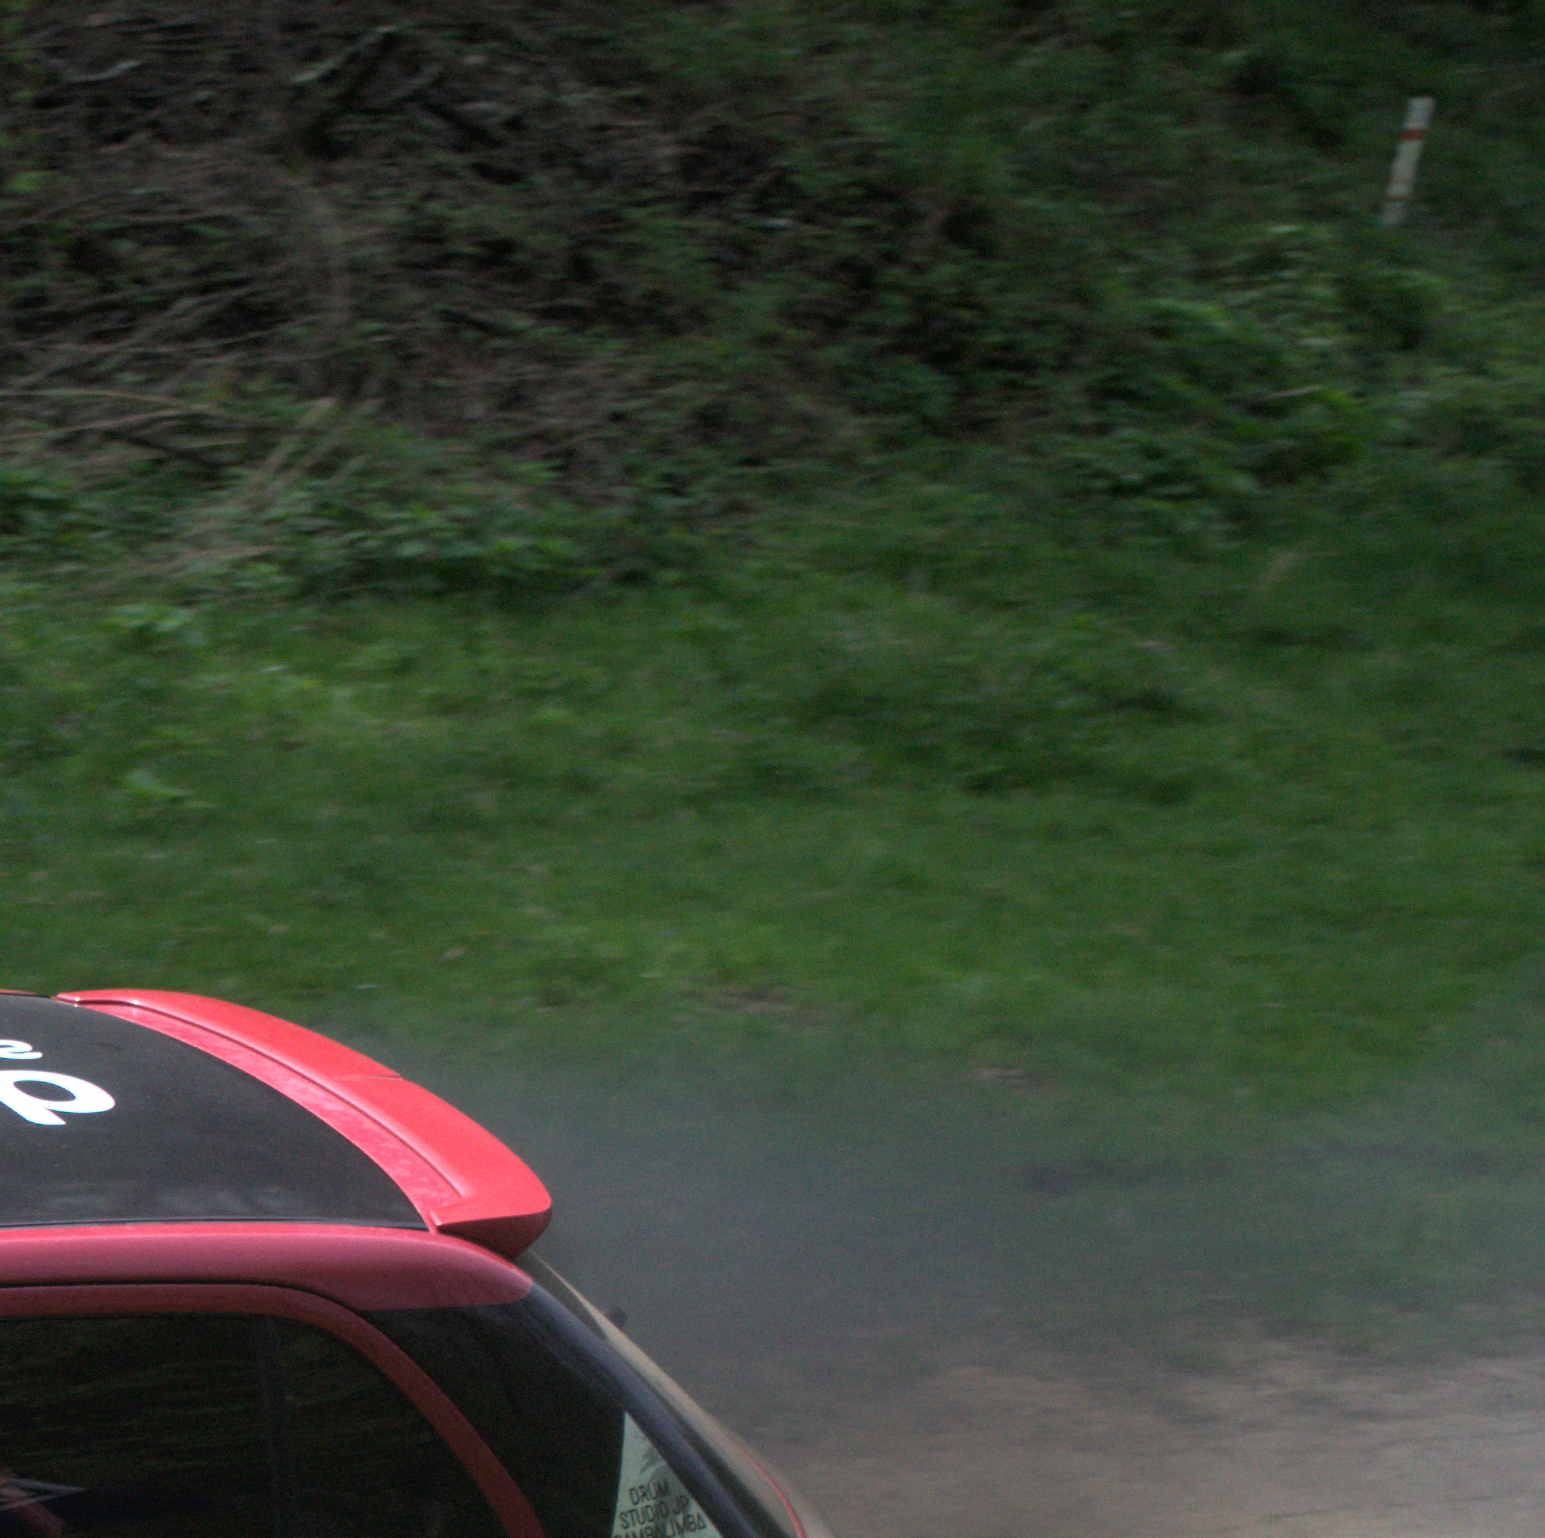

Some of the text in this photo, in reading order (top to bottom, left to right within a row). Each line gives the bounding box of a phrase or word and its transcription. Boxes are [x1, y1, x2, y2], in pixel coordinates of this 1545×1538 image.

[628, 1479, 670, 1506] DRUM
[618, 1495, 690, 1530] STUDIO JP
